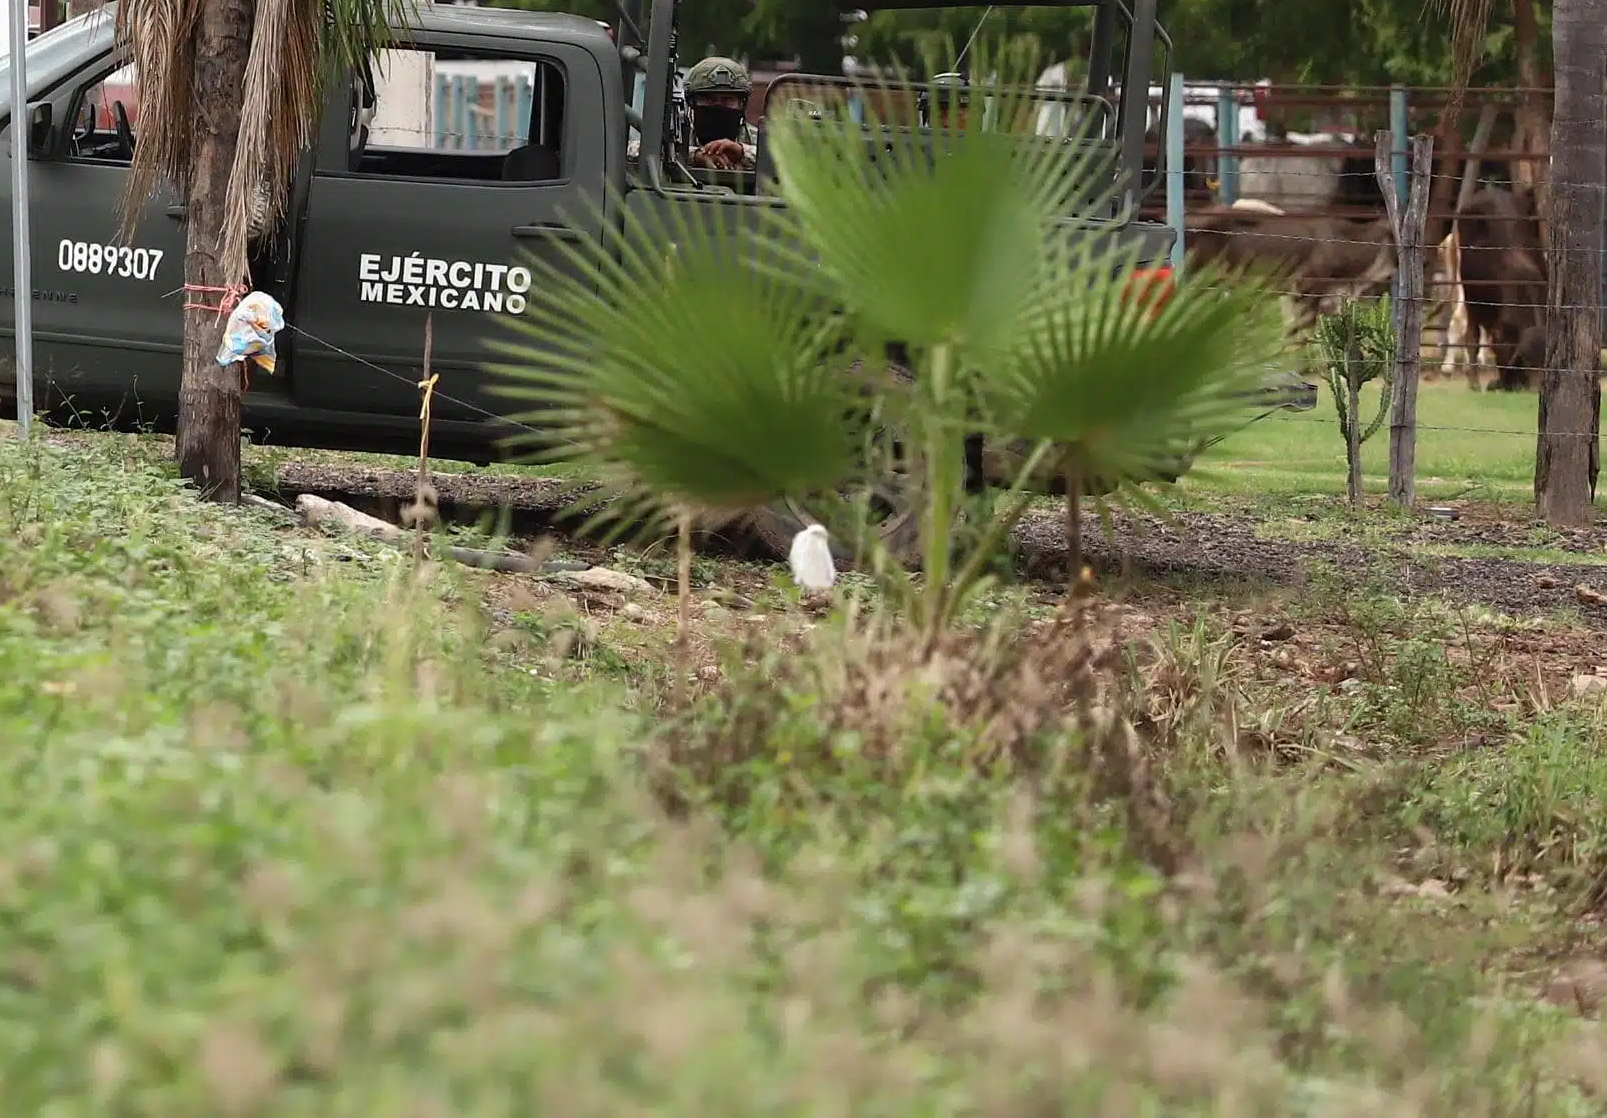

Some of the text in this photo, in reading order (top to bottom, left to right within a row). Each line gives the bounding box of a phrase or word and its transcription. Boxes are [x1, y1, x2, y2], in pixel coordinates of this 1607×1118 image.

[58, 239, 164, 281] 0889307
[359, 251, 532, 294] EJÉRCITO
[360, 282, 526, 314] MEXICANO
